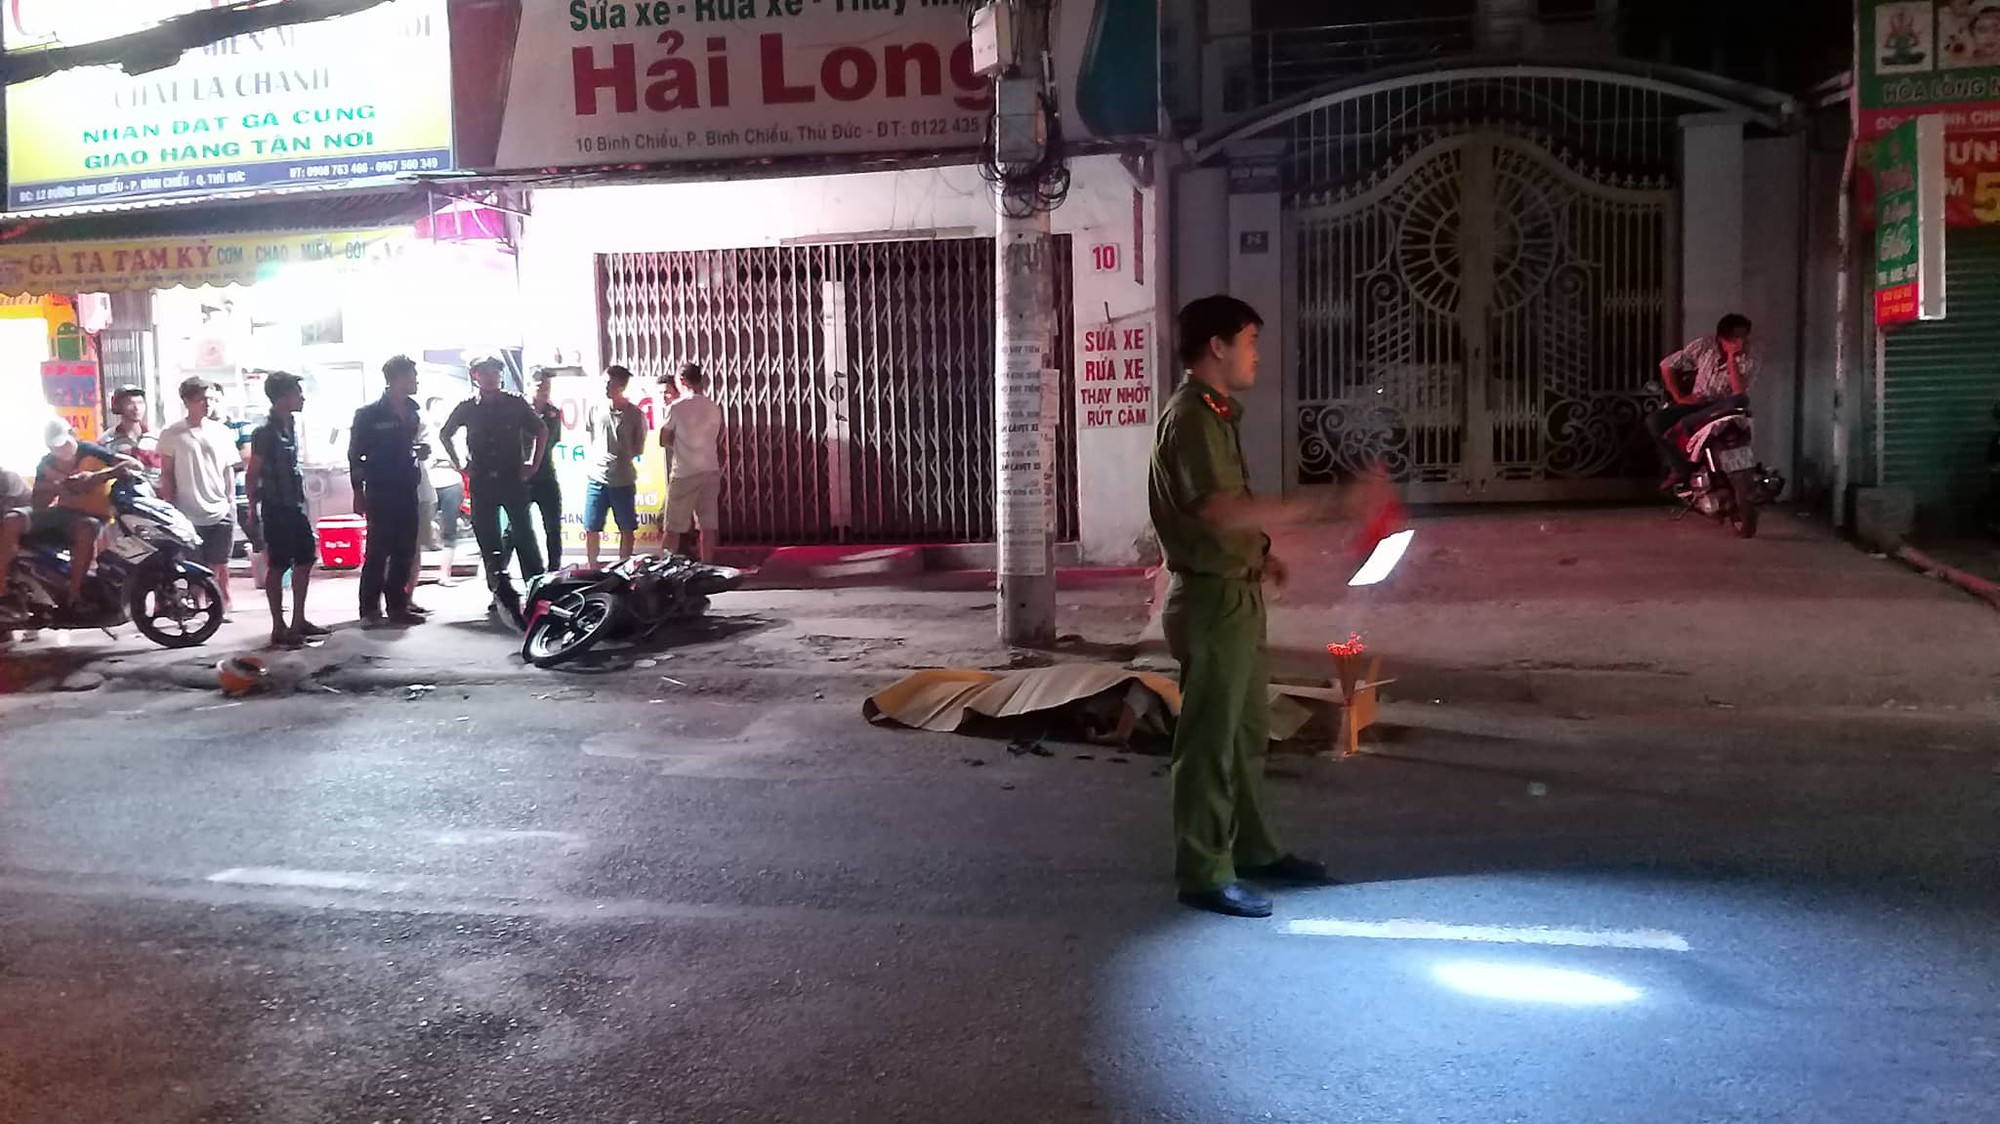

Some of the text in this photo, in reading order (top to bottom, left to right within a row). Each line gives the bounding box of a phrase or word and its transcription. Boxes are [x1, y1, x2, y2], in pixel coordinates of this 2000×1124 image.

[635, 2, 670, 26] xe
[572, 30, 994, 116] Hải Long
[911, 119, 948, 136] 0122
[952, 116, 980, 134] 435
[71, 251, 105, 273] TA
[114, 246, 168, 271] TAM
[1092, 245, 1116, 270] 10
[1123, 328, 1145, 350] XE
[1124, 358, 1145, 379] XE
[1080, 388, 1112, 405] THAY
[1087, 405, 1113, 427] RÚT
